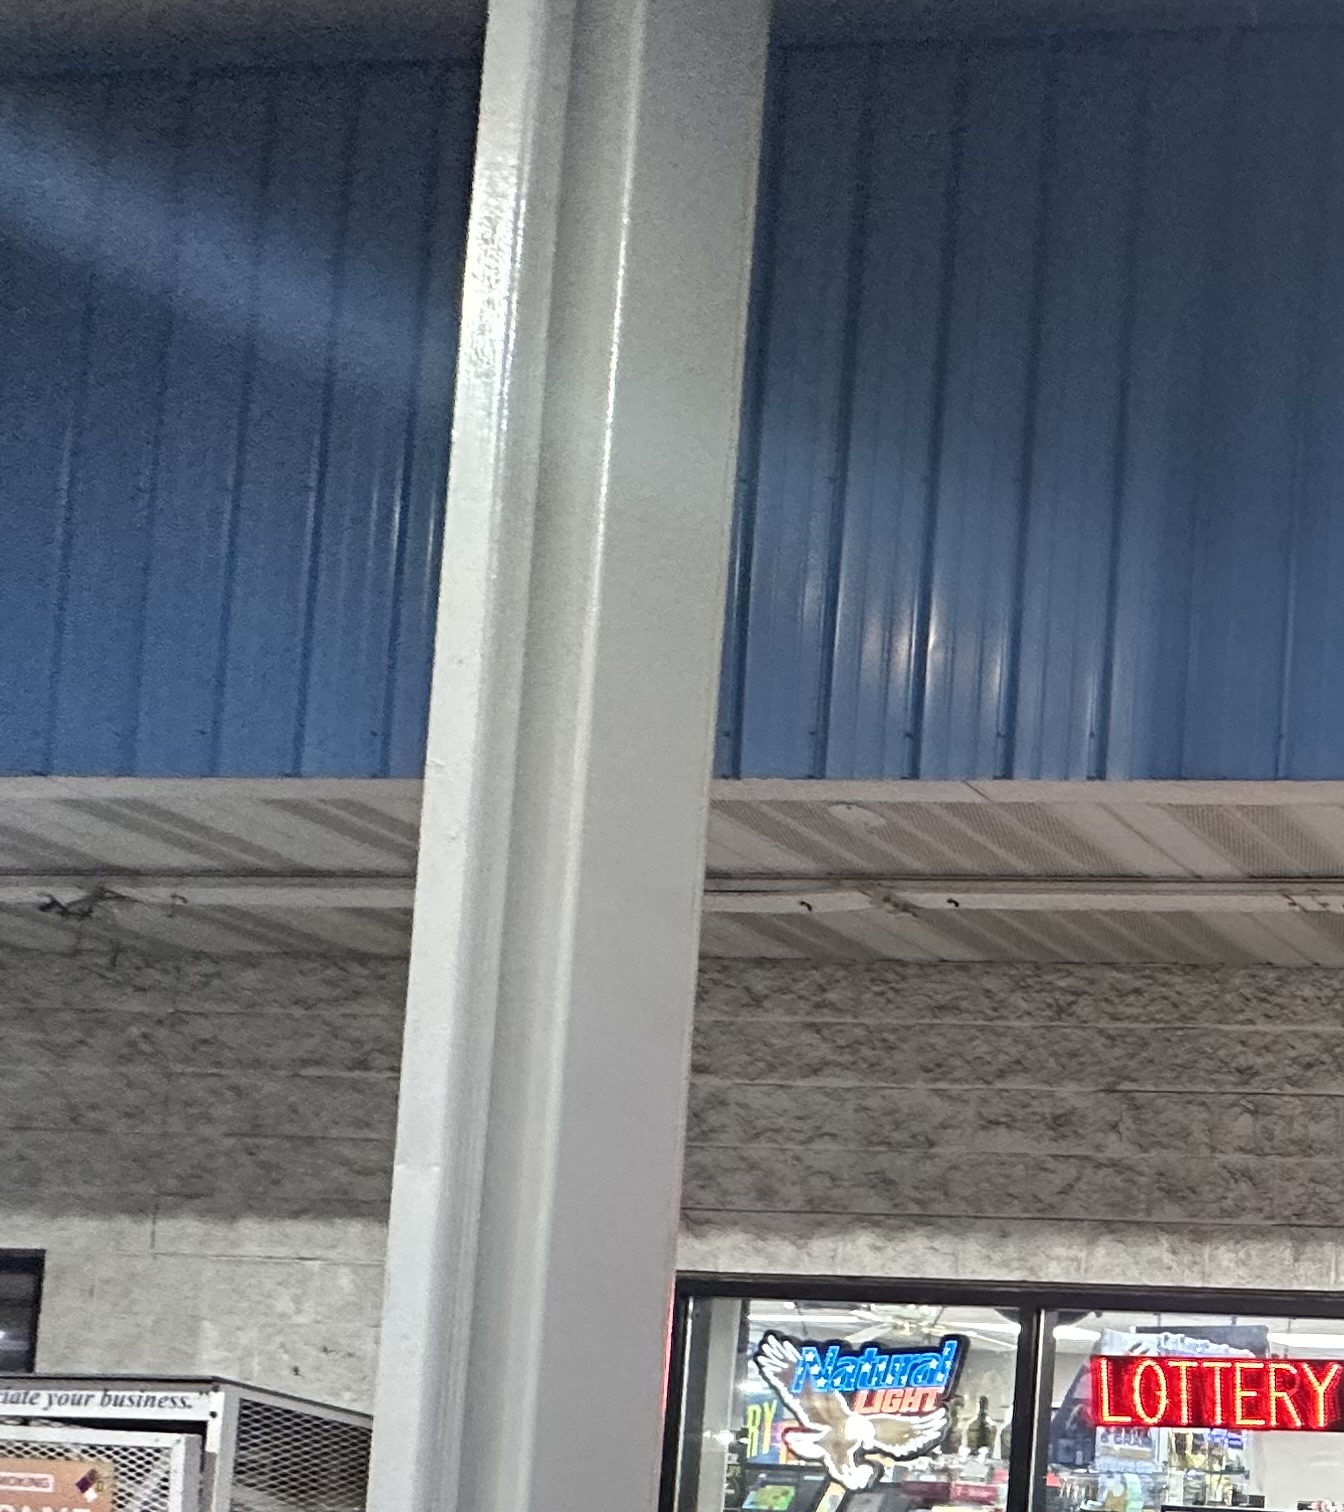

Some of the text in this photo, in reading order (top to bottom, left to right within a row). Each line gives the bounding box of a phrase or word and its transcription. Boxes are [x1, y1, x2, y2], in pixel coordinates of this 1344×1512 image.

[791, 1340, 958, 1394] Natural
[44, 1391, 94, 1411] your
[98, 1389, 193, 1409] business.
[855, 1387, 944, 1415] LIGHT
[1100, 1357, 1344, 1428] LOTTERY
